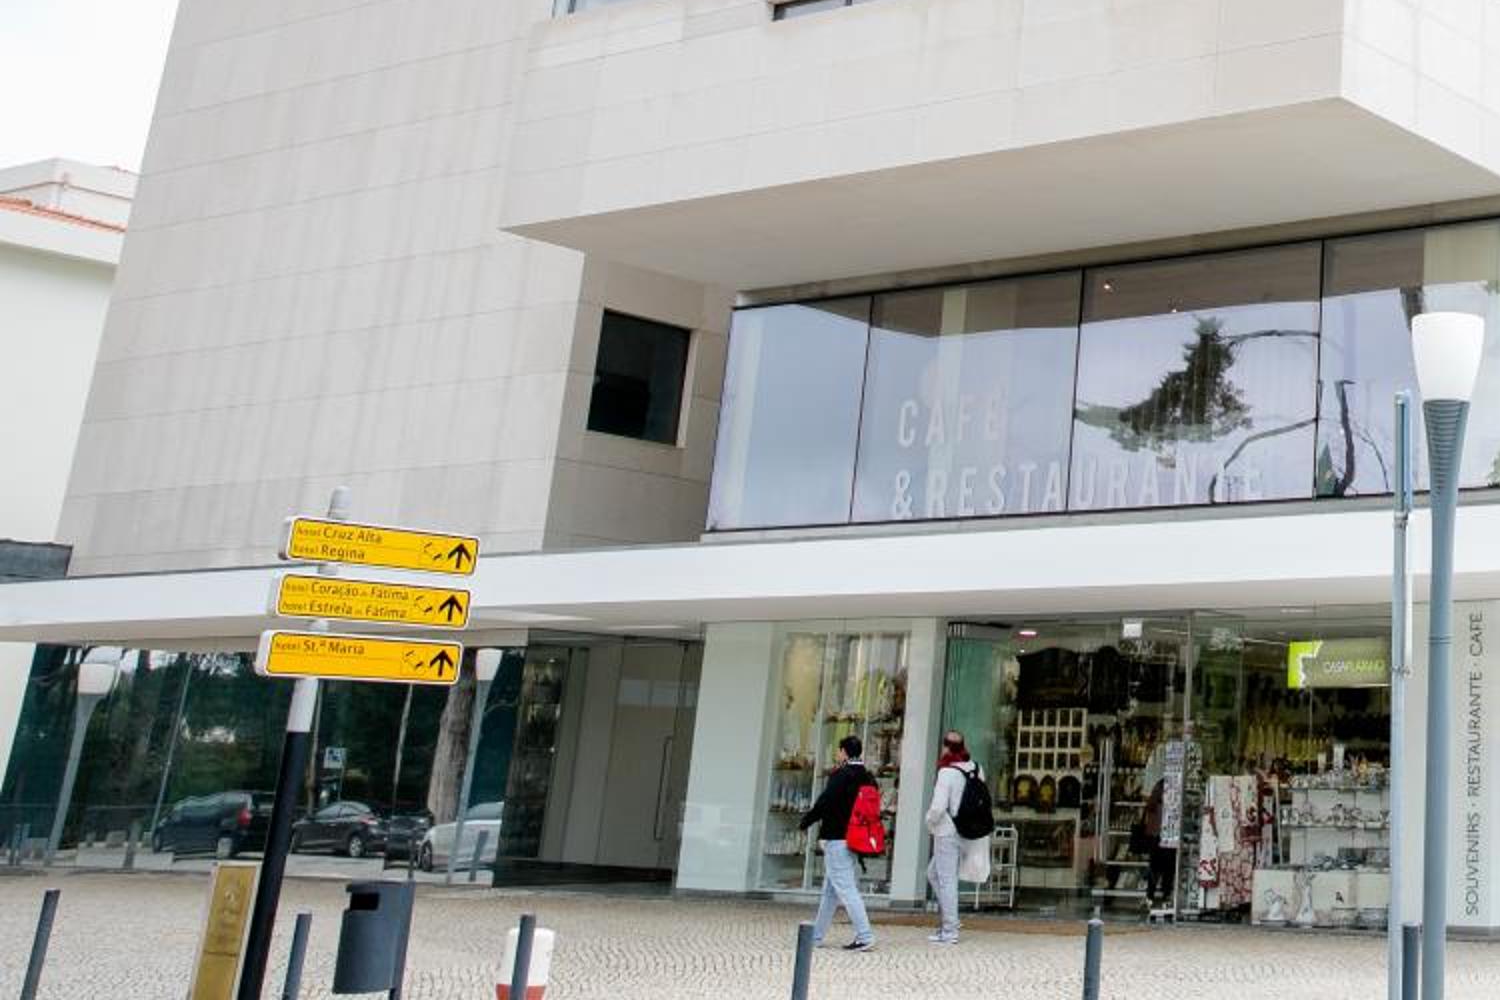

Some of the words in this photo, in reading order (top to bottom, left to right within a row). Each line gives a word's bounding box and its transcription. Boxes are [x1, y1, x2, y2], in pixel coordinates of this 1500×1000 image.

[893, 470, 913, 517] &
[926, 451, 1264, 518] RESTAURANTE
[323, 527, 353, 541] Cruz
[357, 531, 383, 544] Alta
[321, 544, 366, 561] Regina
[309, 600, 353, 615] Estrela
[329, 642, 365, 656] Maria
[1468, 671, 1484, 798] RESTAURANTE
[1465, 812, 1482, 916] SOUVENIRS
